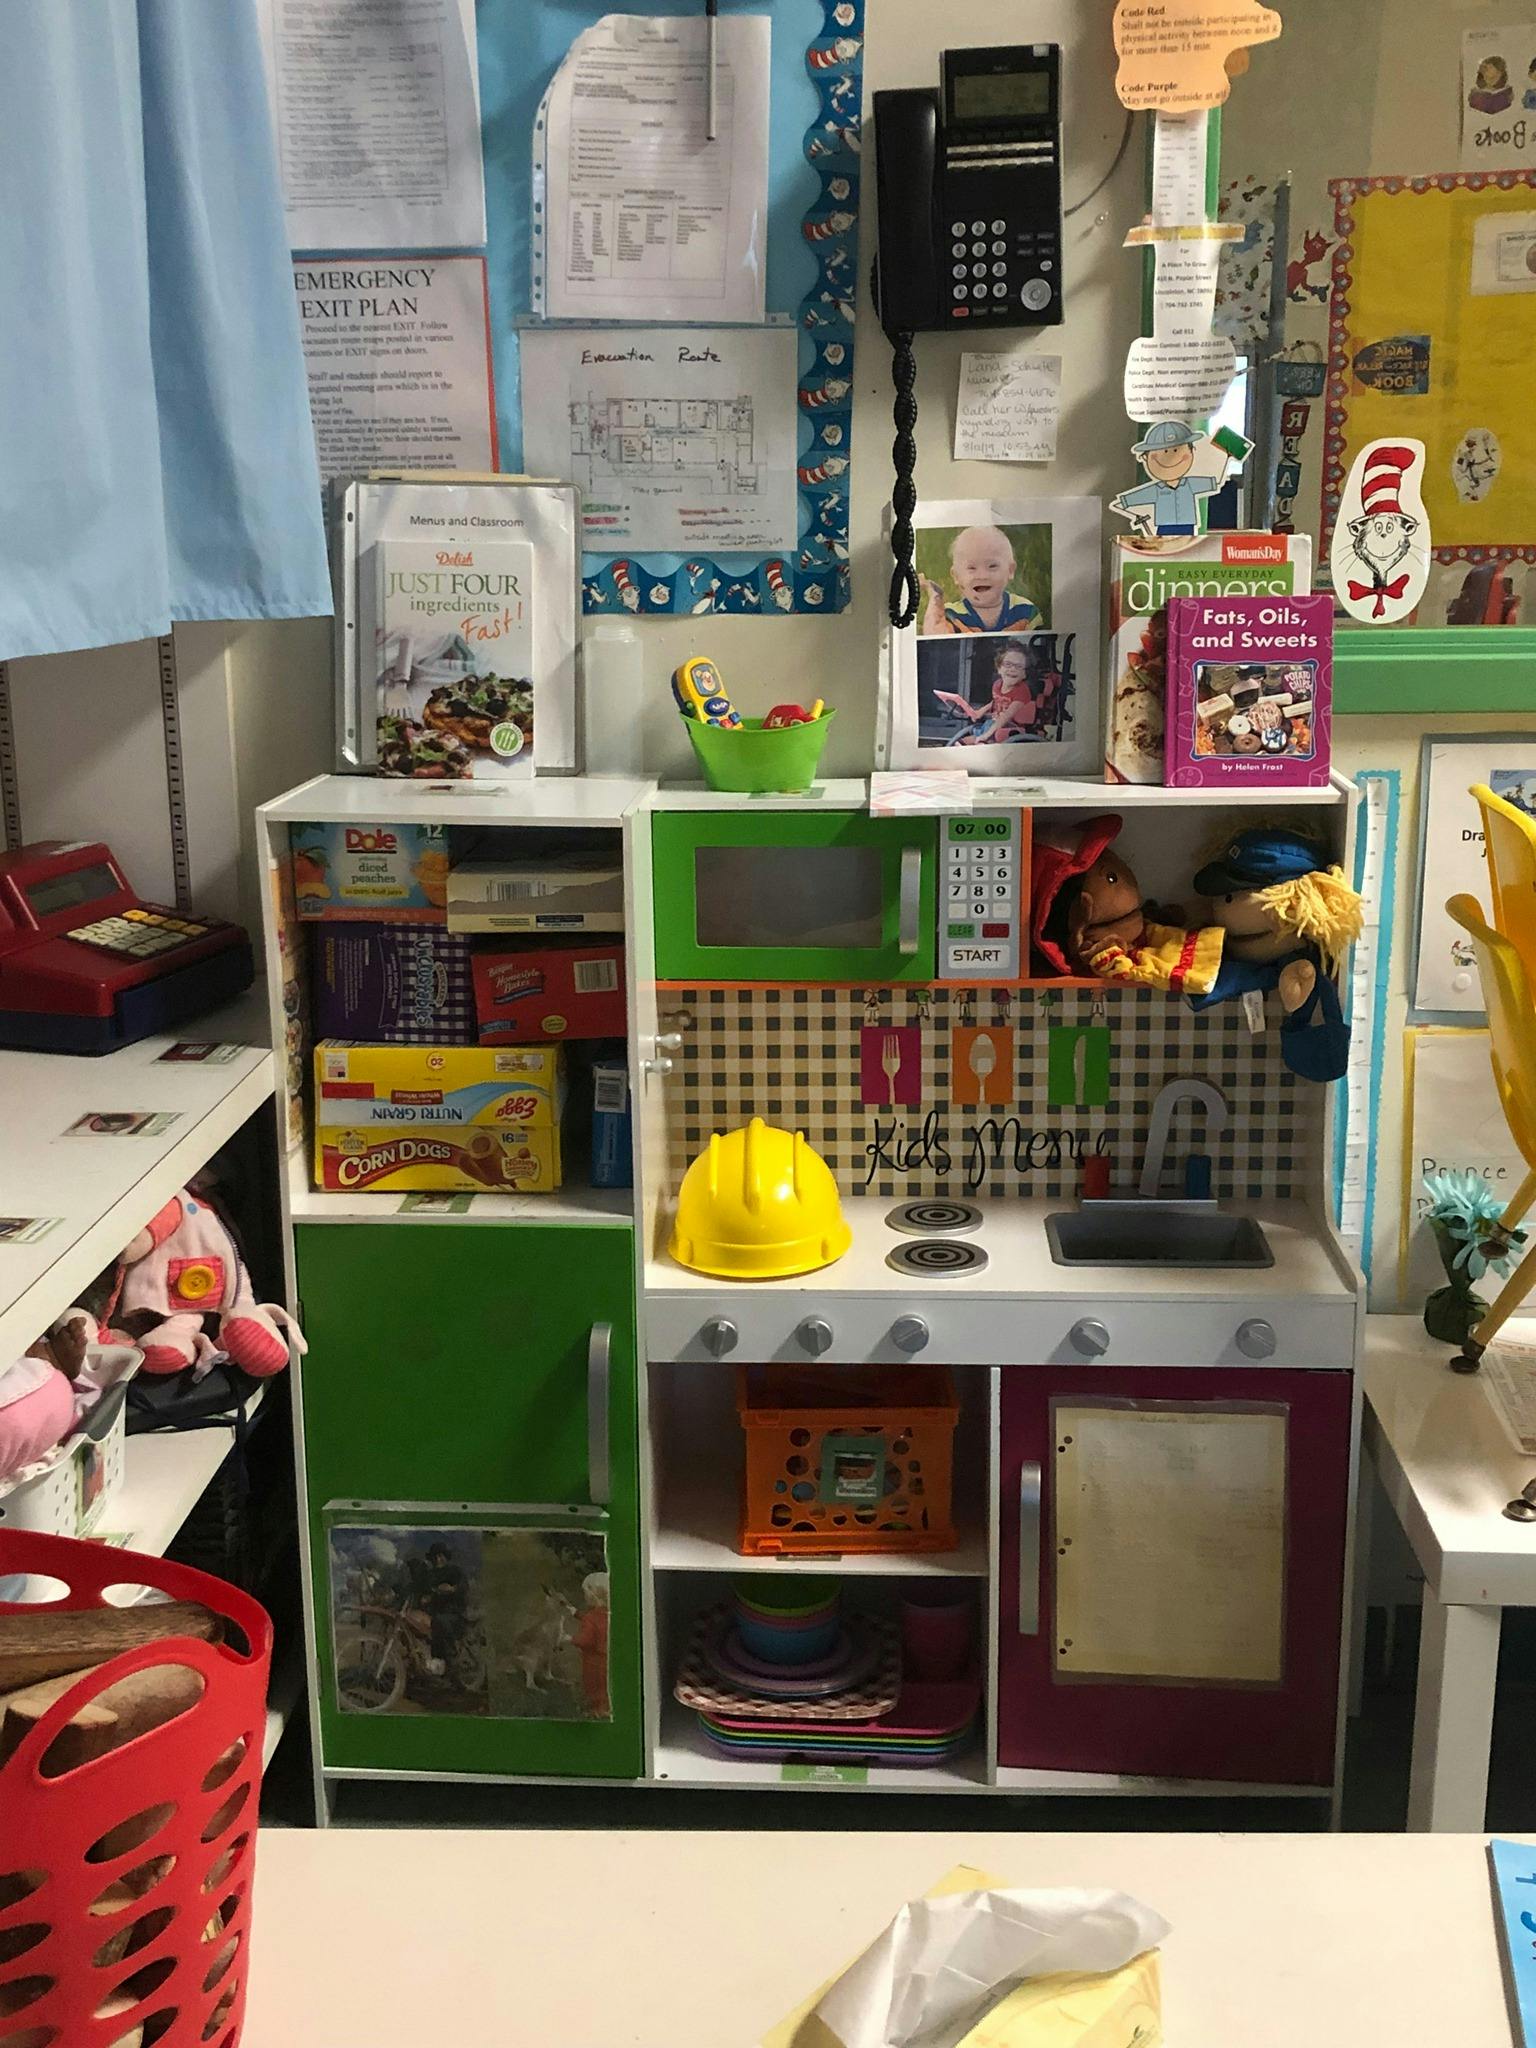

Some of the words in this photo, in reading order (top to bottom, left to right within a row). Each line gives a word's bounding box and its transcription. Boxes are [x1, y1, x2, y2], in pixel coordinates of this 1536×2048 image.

[1121, 9, 1144, 17] Code
[1147, 7, 1165, 16] Red
[1145, 21, 1160, 29] not
[1161, 20, 1171, 28] be
[1174, 18, 1205, 27] outside
[1207, 14, 1261, 26] participating
[1121, 32, 1156, 44] physical
[1158, 31, 1190, 42] activity
[1193, 29, 1228, 38] between
[1255, 26, 1268, 34] and
[1122, 47, 1133, 56] for
[1136, 47, 1158, 55] more
[1160, 45, 1178, 53] than
[1121, 84, 1144, 93] Code
[1147, 82, 1178, 93] Purple
[1143, 95, 1158, 103] not
[1160, 96, 1170, 105] go
[1172, 93, 1203, 102] outside
[294, 268, 436, 290] EMERGENCY
[301, 299, 352, 319] EXIT
[359, 297, 418, 316] PLAN
[393, 322, 415, 330] EXIT
[420, 321, 448, 330] Follow
[345, 348, 368, 356] EXIT
[581, 347, 654, 364] Evacuation
[678, 346, 721, 363] Route
[380, 370, 406, 378] should
[408, 370, 432, 380] report
[343, 384, 374, 393] meeting
[395, 382, 419, 390] which
[440, 381, 452, 389] the
[410, 515, 445, 527] Menus
[448, 516, 468, 527] and
[470, 516, 524, 527] Classroom
[435, 552, 474, 567] Delish
[1178, 570, 1208, 579] EASY
[1213, 569, 1275, 578] EVERYDAY
[387, 573, 447, 598] JUST
[451, 573, 522, 597] FOUR
[1128, 568, 1287, 611] dinners
[410, 596, 500, 616] ingredients
[460, 601, 523, 643] Fast!
[1203, 609, 1254, 628] Fats,
[1258, 607, 1309, 628] Oils,
[1192, 632, 1234, 648] and
[1241, 631, 1318, 648] Sweets
[1284, 670, 1311, 682] POTATO
[1288, 679, 1313, 691] CHIPS
[1222, 763, 1233, 771] by
[1235, 763, 1261, 771] Helen
[1262, 763, 1283, 771] Frost
[423, 824, 443, 838] 12
[1462, 829, 1486, 841] Dra
[345, 829, 397, 850] Dole
[975, 848, 984, 859] 2
[997, 848, 1006, 859] 3
[358, 862, 388, 873] diced
[953, 867, 961, 878] 4
[976, 867, 984, 877] 5
[997, 867, 1007, 878] 6
[351, 874, 397, 884] peaches
[952, 886, 961, 896] 7
[973, 886, 983, 897] 8
[996, 886, 1006, 896] 9
[974, 904, 985, 914] 0
[953, 949, 1002, 961] START
[431, 1057, 444, 1066] 20
[372, 1107, 416, 1120] GRAIN
[421, 1107, 463, 1120] NUTRI
[495, 1096, 538, 1120] Eggo
[502, 1132, 515, 1143] 16
[865, 1110, 952, 1186] Kids
[338, 1149, 396, 1186] CORN
[399, 1140, 451, 1161] DOGS
